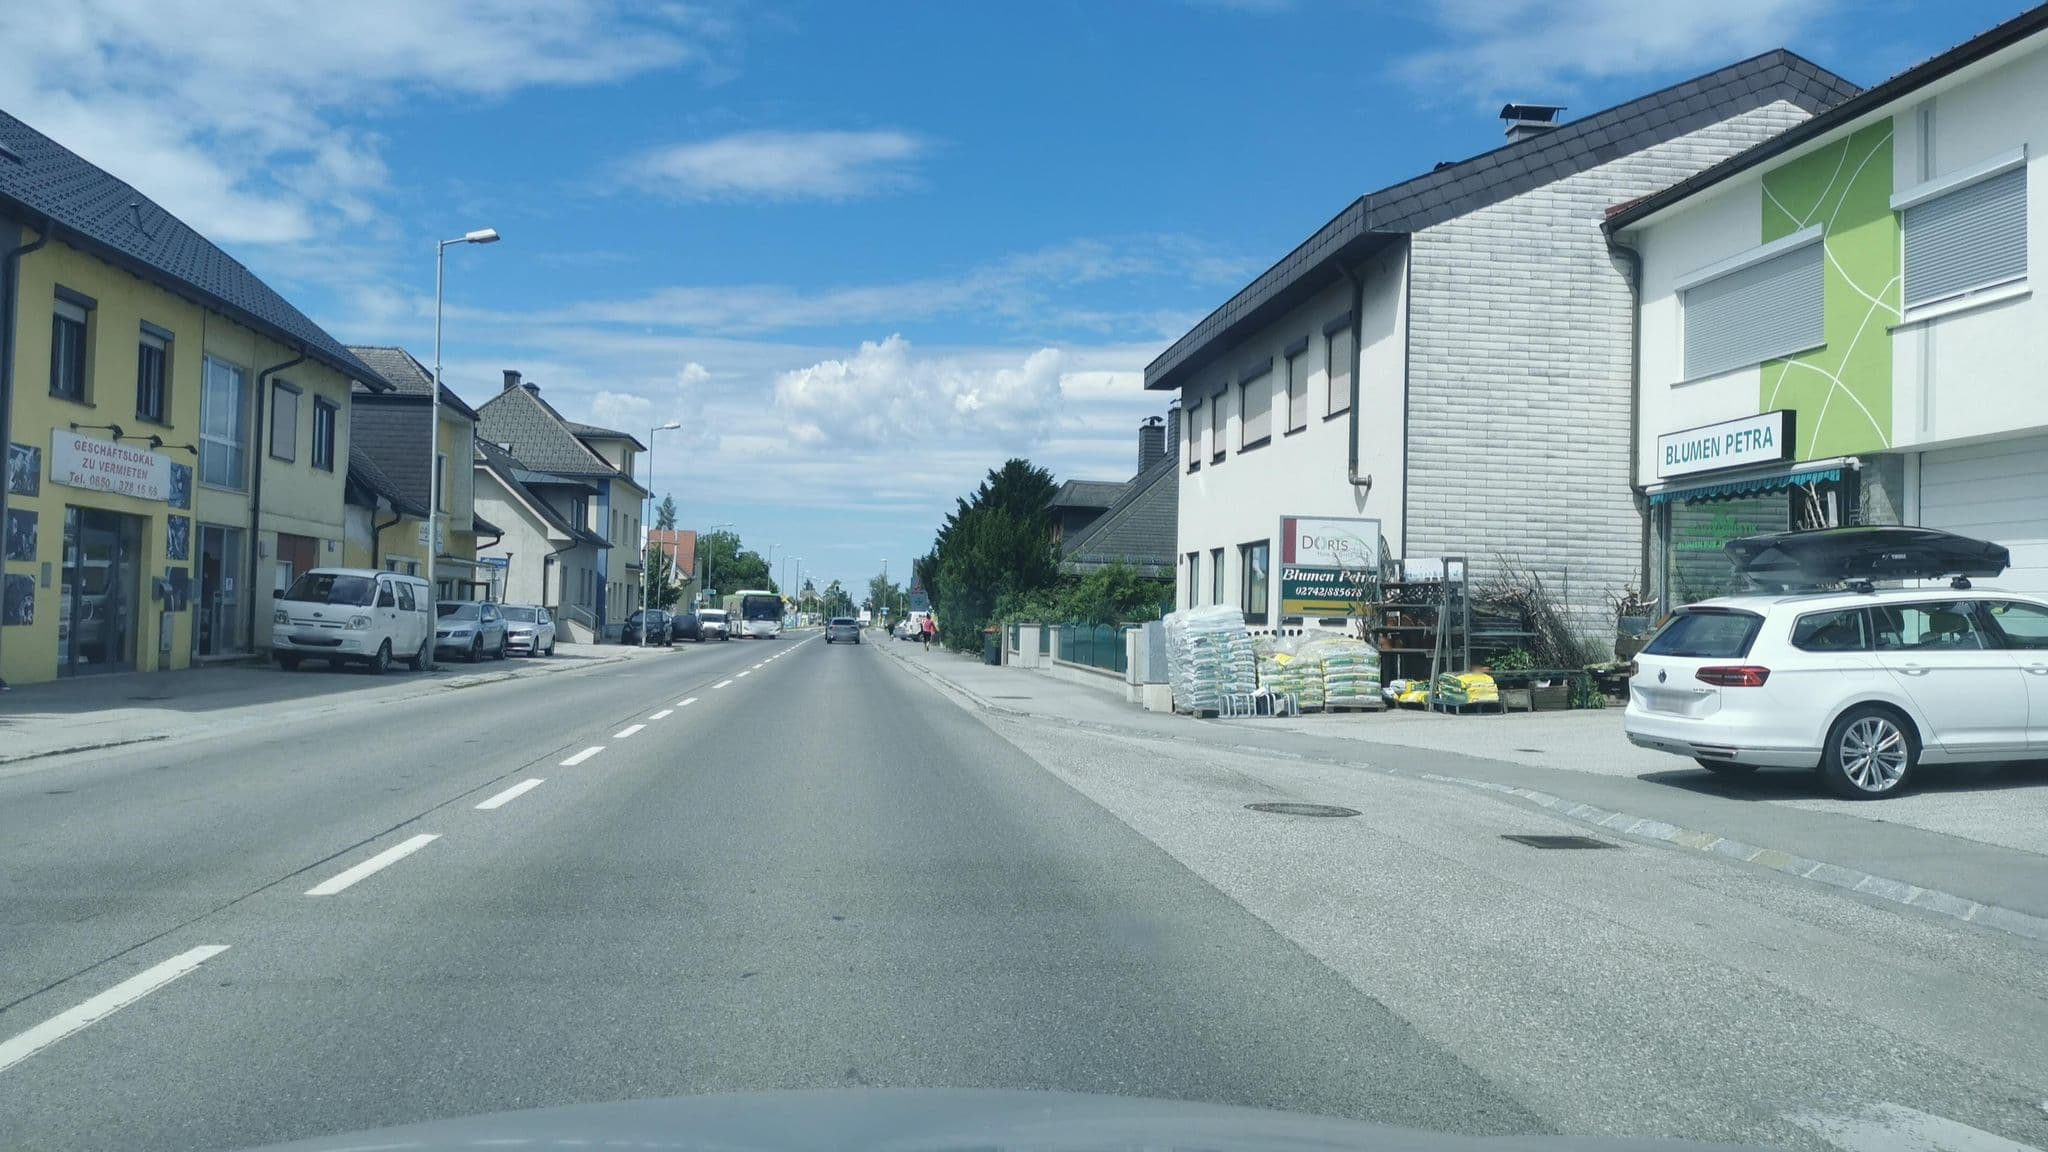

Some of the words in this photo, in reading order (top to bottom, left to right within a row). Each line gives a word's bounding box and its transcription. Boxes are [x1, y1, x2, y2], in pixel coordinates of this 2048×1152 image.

[1666, 436, 1720, 465] BLUMEN
[1726, 426, 1773, 455] PETRA
[82, 458, 95, 469] ZU
[99, 461, 148, 480] VERMIETEN
[69, 472, 85, 484] Tel.
[1282, 568, 1335, 582] Blumen
[1339, 570, 1377, 583] Petra
[1295, 587, 1363, 597] 02742/885678
